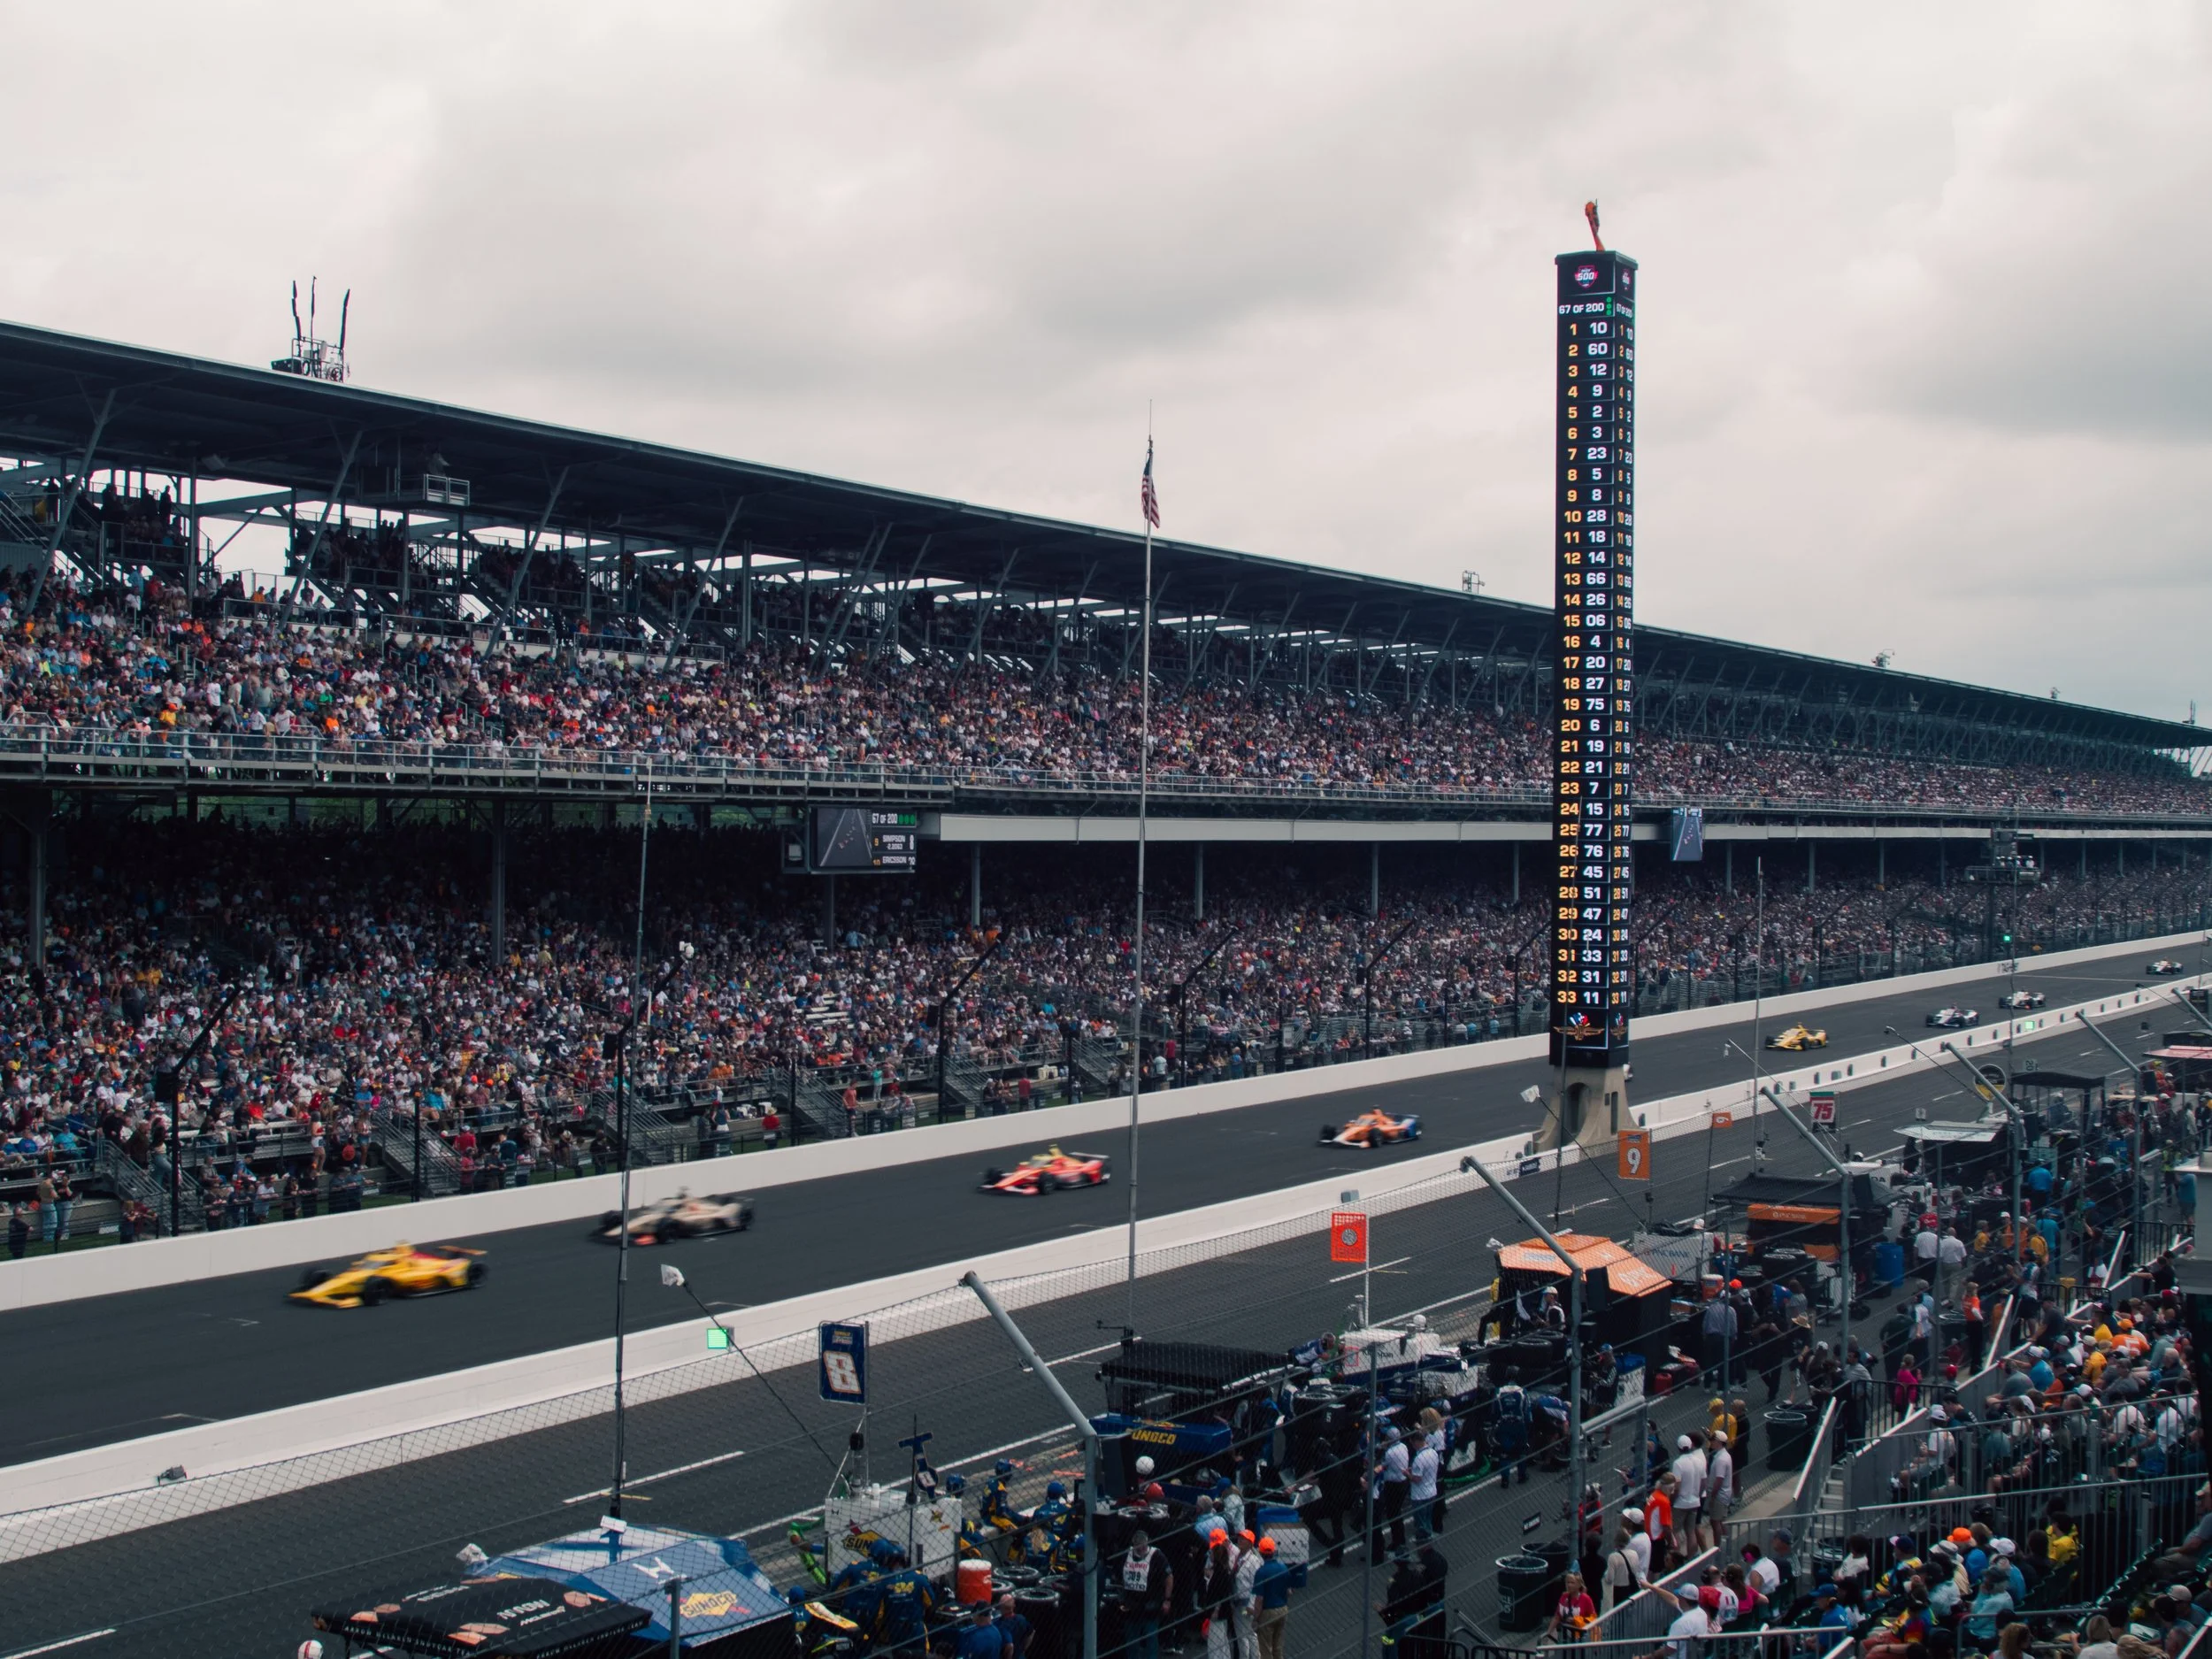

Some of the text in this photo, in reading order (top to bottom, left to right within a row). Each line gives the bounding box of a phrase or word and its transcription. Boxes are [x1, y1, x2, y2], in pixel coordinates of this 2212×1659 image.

[1577, 272, 1594, 281] 500
[1558, 303, 1604, 314] 67 OF 200
[1571, 322, 1607, 335] 1 10
[1569, 342, 1607, 356] 2 60
[1569, 364, 1607, 377] 3 12
[1568, 385, 1602, 397] 4 9
[1569, 405, 1601, 419] 5 2
[1569, 426, 1601, 439] 6 3
[1568, 447, 1606, 460] 7 23
[1568, 468, 1601, 480] 8 5
[1568, 489, 1601, 502] 9 8
[1565, 510, 1606, 522] 10 28
[1564, 531, 1605, 543] 11 18
[1564, 551, 1605, 564] 12 14
[1564, 572, 1606, 585] 13 66
[1564, 594, 1605, 605] 14 26
[1564, 614, 1605, 626] 15 06
[1563, 635, 1601, 648] 16 4
[1563, 657, 1605, 668] 17 20
[1563, 678, 1604, 689] 18 27
[1563, 698, 1604, 710] 19 75
[1562, 719, 1600, 731] 20 6
[1562, 741, 1603, 752] 21 19
[1561, 761, 1602, 772] 22 21
[1561, 782, 1599, 794] 23 7
[1561, 803, 1602, 815] 24 15
[872, 813, 898, 824] 67 OF 200
[1560, 824, 1602, 836] 25 77
[1560, 845, 1602, 856] 26 76
[1560, 865, 1602, 878] 27 45
[1560, 887, 1600, 899] 28 51
[1559, 908, 1601, 919] 29 47
[1559, 928, 1601, 941] 30 24
[1559, 949, 1601, 962] 31 33
[1558, 970, 1599, 983] 32 31
[1558, 991, 1599, 1003] 33 11
[1814, 1102, 1833, 1120] 75
[1626, 1147, 1641, 1175] 9
[823, 1350, 862, 1394] 8
[1129, 1429, 1177, 1445] UNOCO
[845, 1537, 871, 1549] SUN
[683, 1591, 734, 1616] SUNOCO
